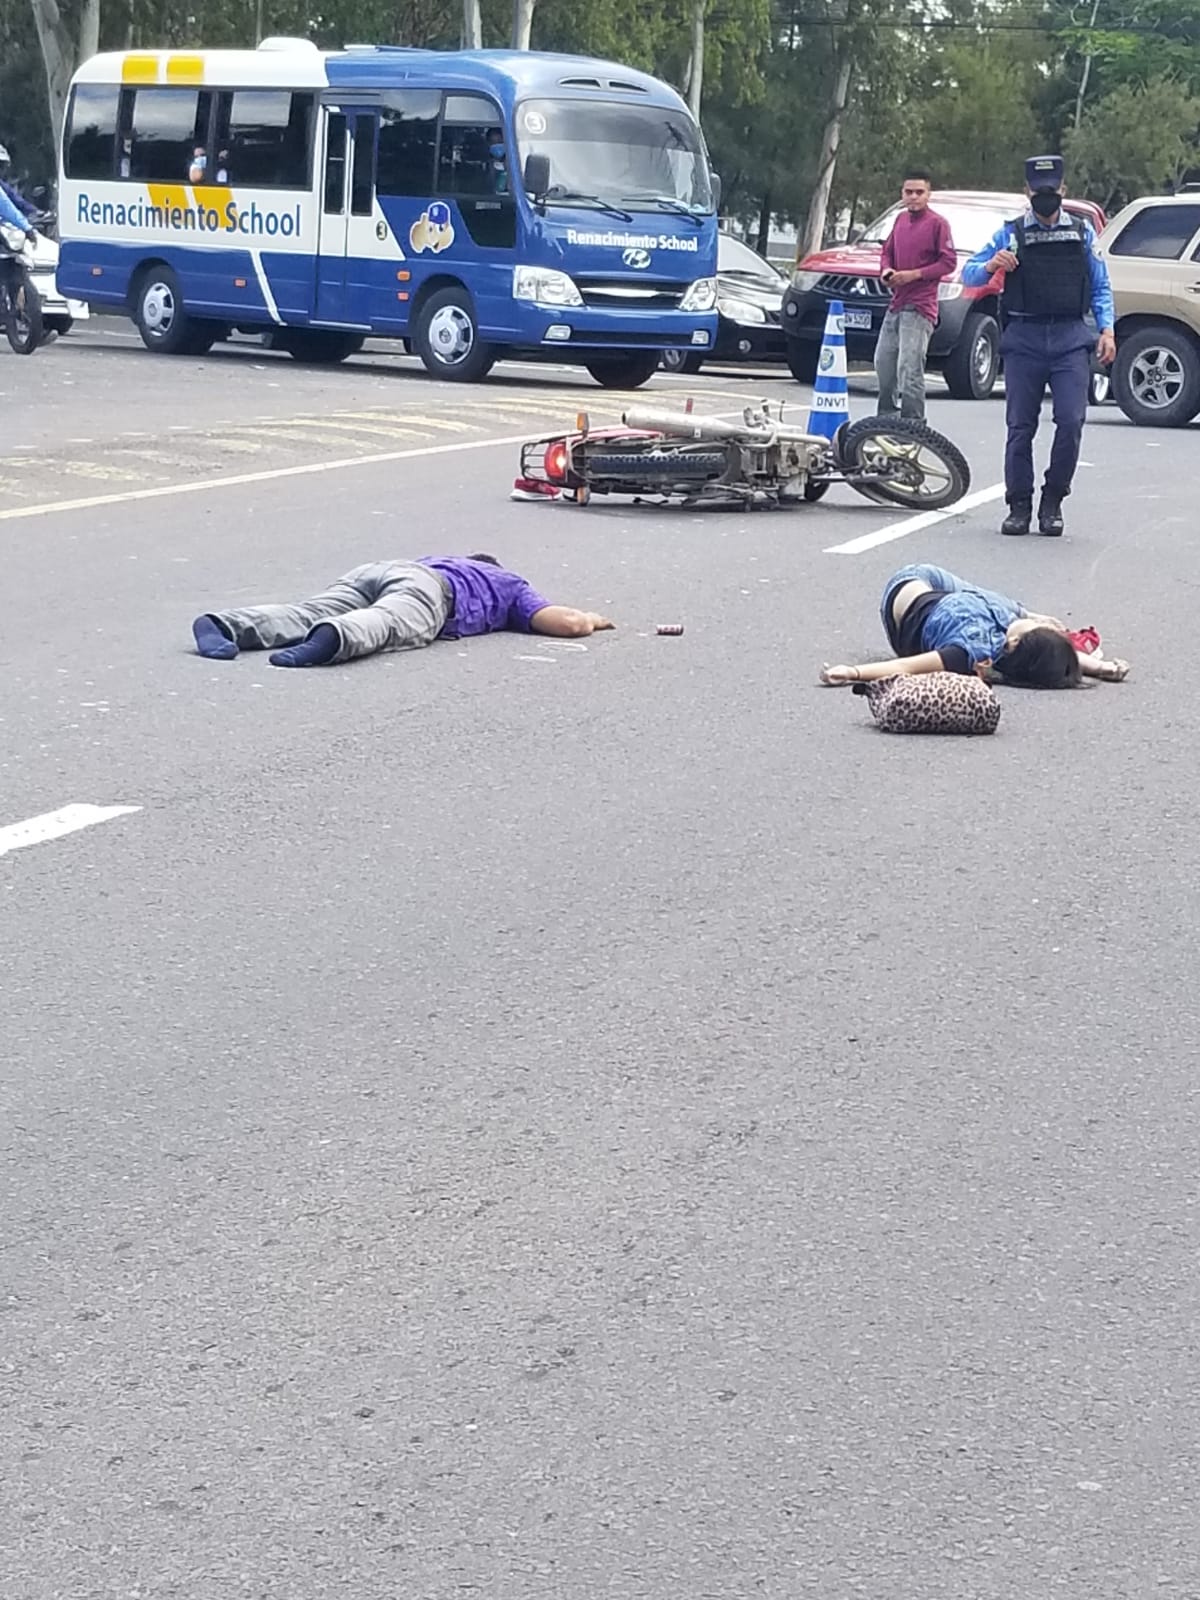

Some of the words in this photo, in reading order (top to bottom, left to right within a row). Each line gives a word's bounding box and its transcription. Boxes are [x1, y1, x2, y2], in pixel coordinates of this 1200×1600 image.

[530, 115, 541, 130] 3
[77, 193, 219, 232] Renacimiento
[225, 201, 301, 237] School
[378, 222, 386, 239] 3
[567, 229, 657, 249] Renacimiento
[658, 235, 698, 252] School
[816, 396, 846, 408] DNVT
